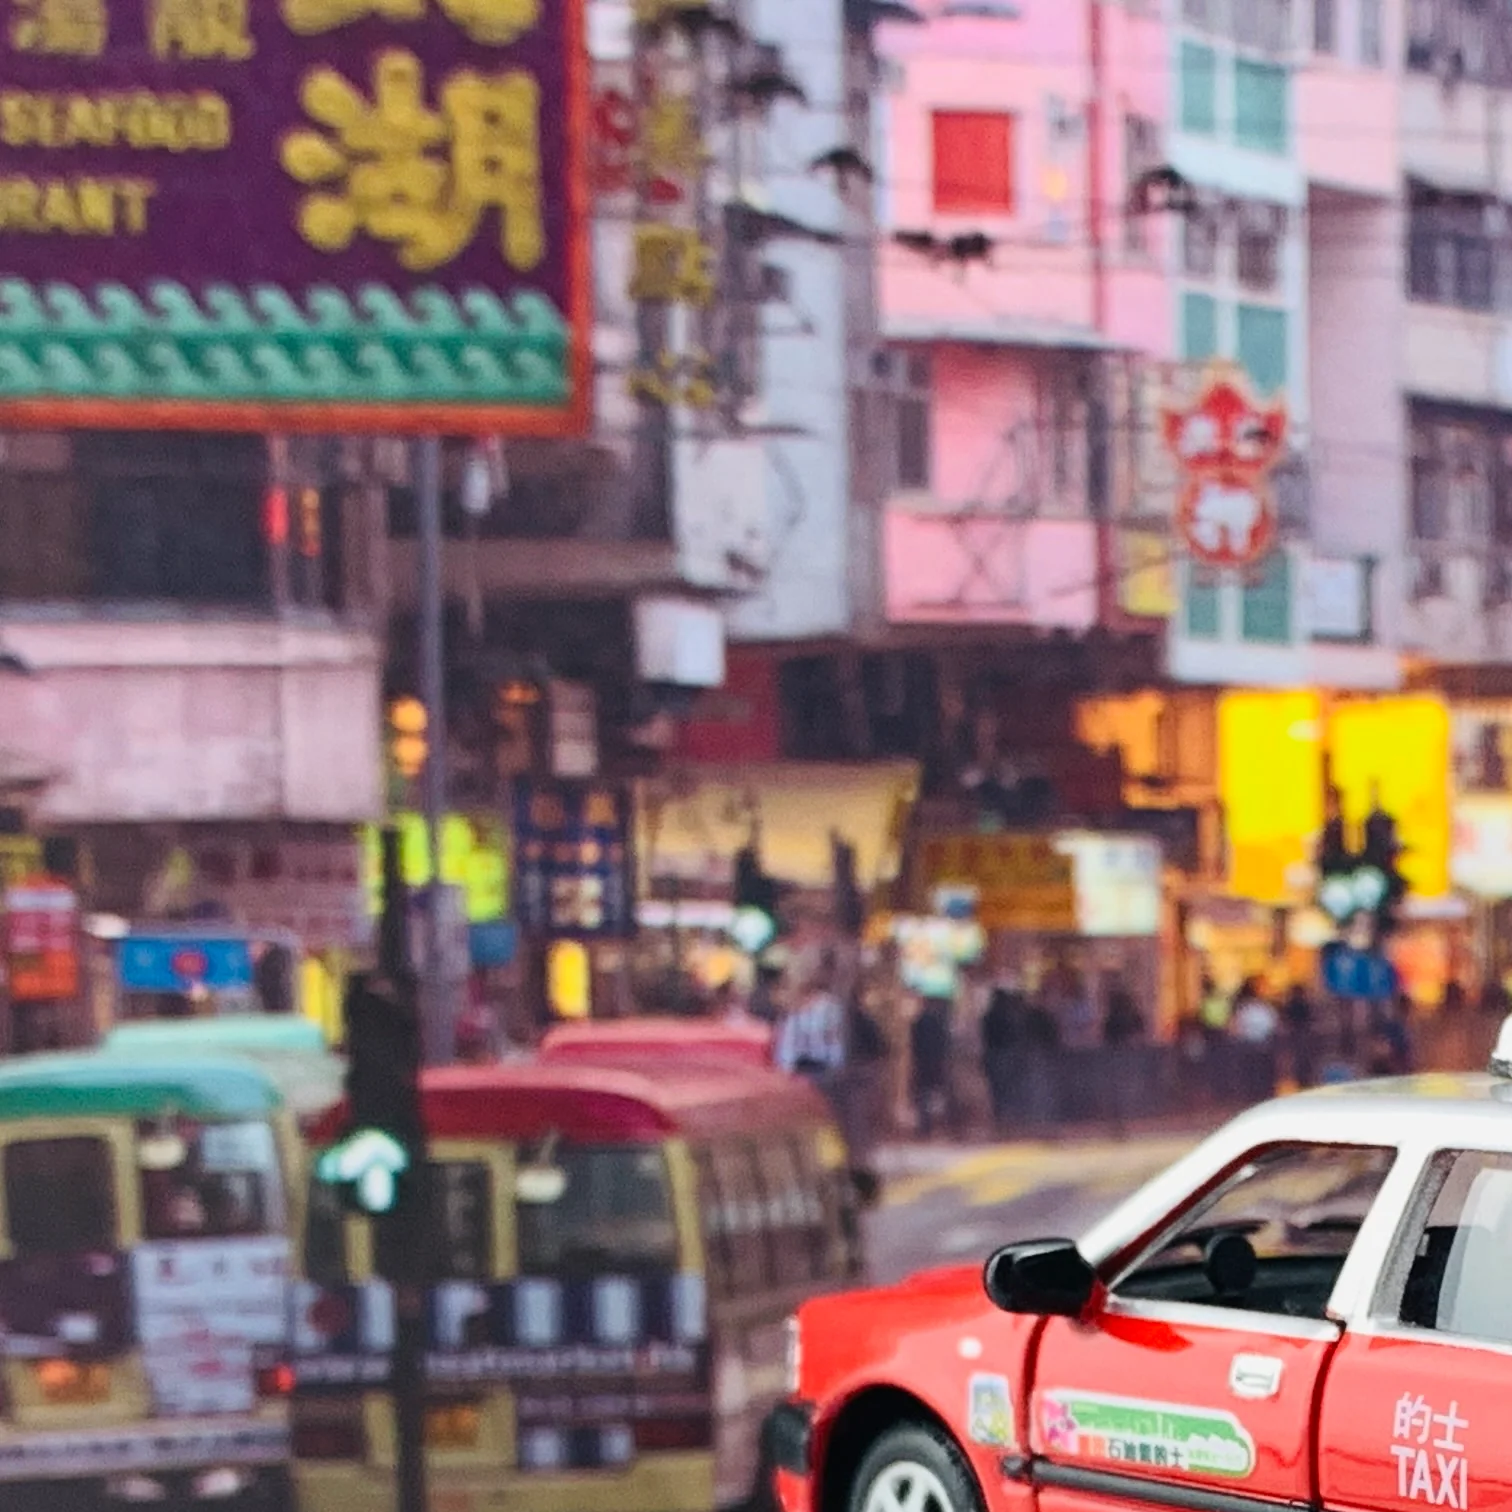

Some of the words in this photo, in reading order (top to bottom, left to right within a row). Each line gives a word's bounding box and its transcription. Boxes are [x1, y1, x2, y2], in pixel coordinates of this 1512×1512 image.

[283, 0, 545, 270] 湖
[1393, 1391, 1469, 1452] 的士
[1390, 1444, 1468, 1512] TAXI
